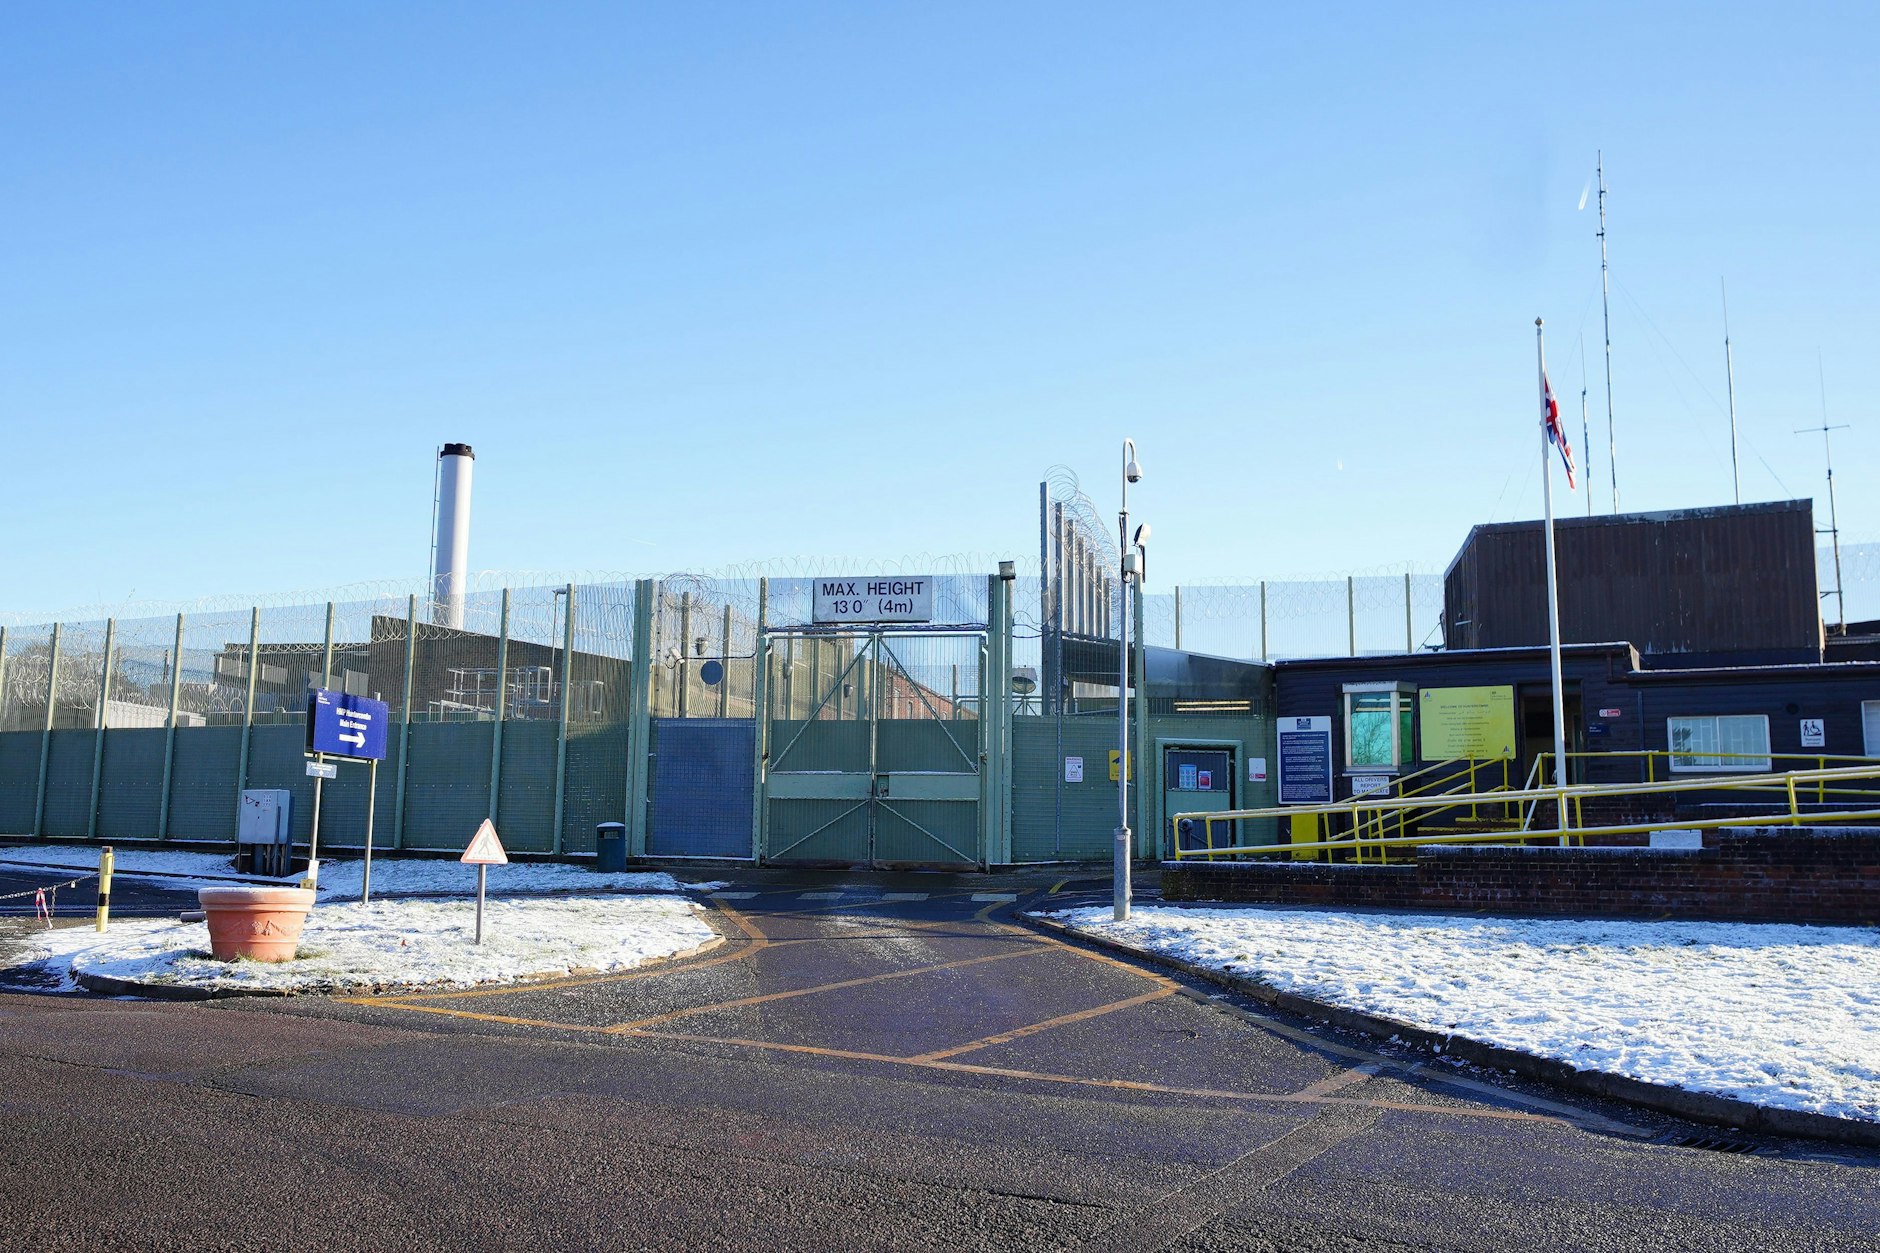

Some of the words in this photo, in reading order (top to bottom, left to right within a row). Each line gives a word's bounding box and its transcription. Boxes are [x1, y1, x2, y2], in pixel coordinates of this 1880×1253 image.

[822, 583, 860, 596] MAX.
[867, 581, 924, 595] HEIGHT
[878, 598, 913, 614] (4m)
